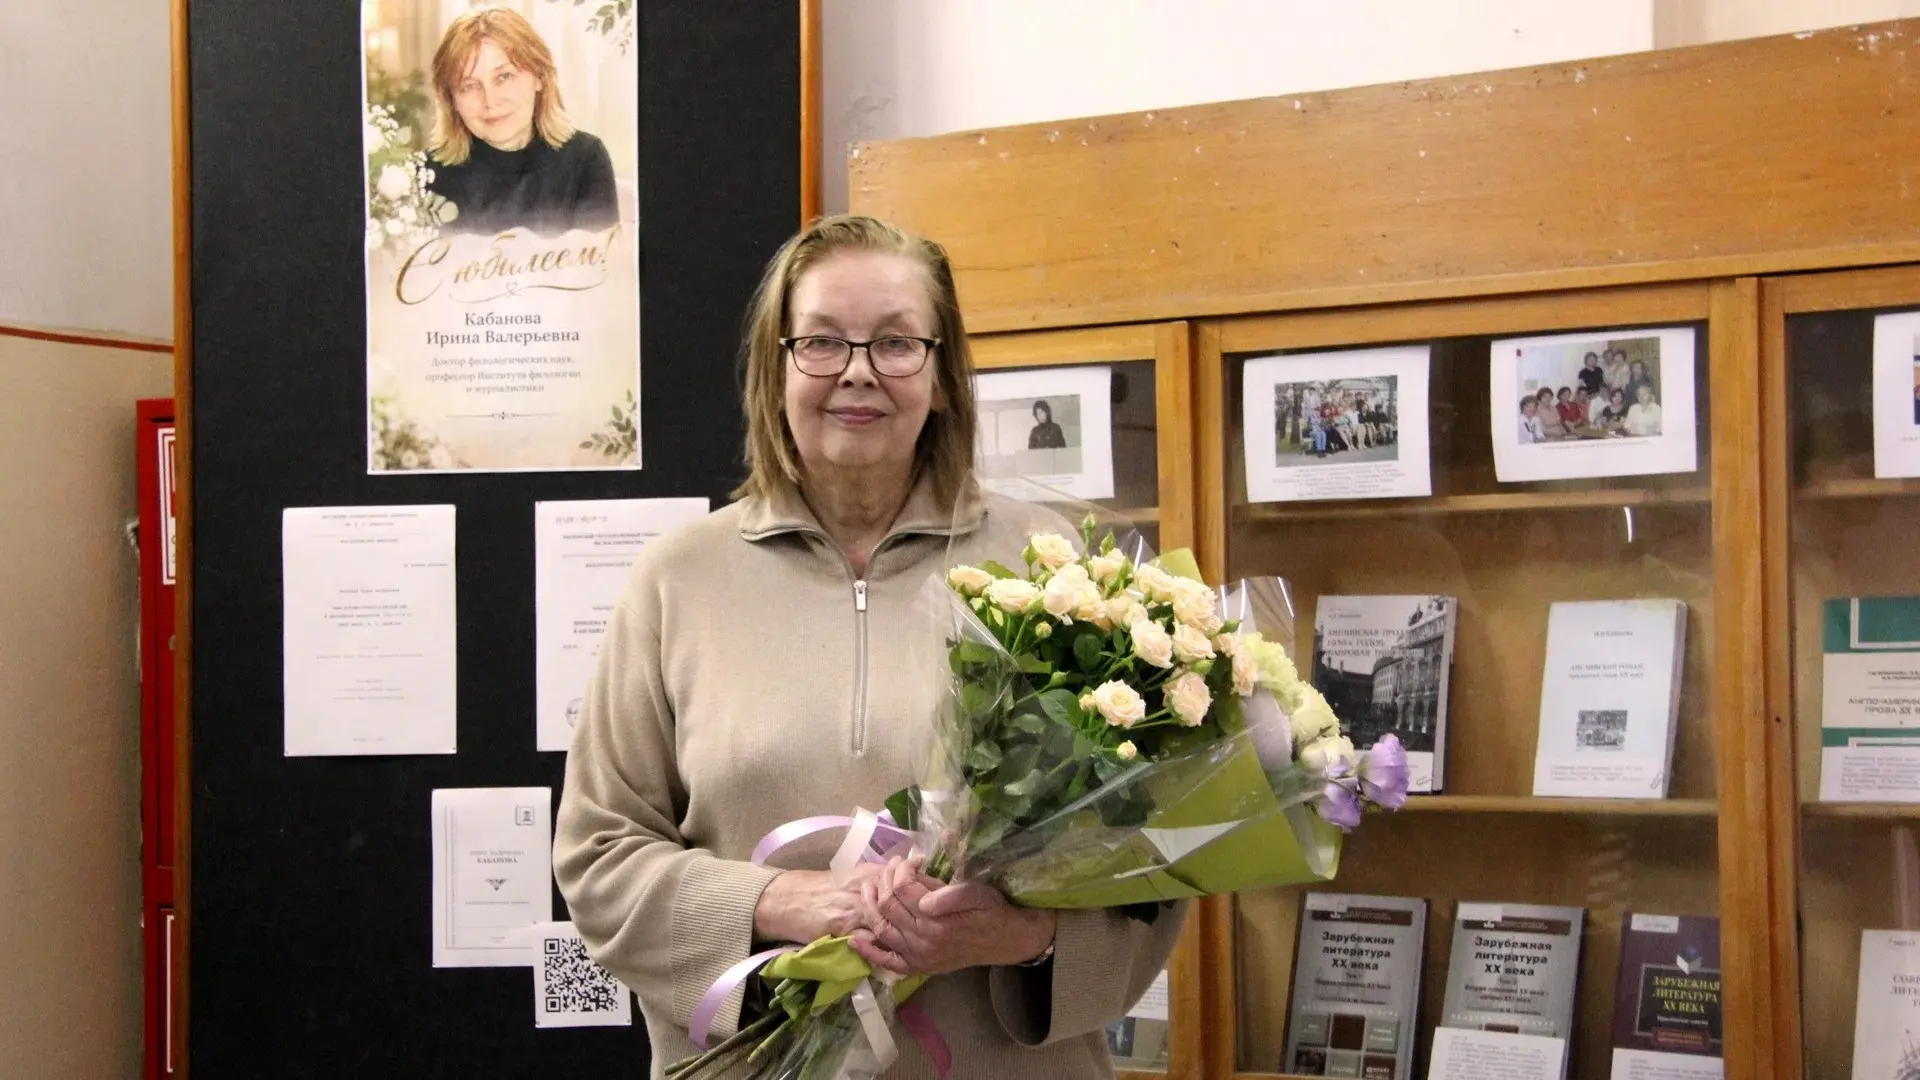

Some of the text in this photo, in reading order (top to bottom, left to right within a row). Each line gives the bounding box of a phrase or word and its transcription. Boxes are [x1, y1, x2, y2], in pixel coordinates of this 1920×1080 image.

[396, 229, 616, 306] С юбилеем!
[465, 311, 542, 326] Кабанова
[426, 329, 580, 348] Ирина Валерьевна
[430, 357, 466, 368] Доктор
[468, 355, 548, 367] филологических
[425, 369, 581, 383] профессор Института филологии
[1322, 931, 1395, 947] Зарубежная
[1475, 936, 1553, 951] Зарубежная
[1322, 945, 1391, 959] литература
[1474, 951, 1548, 965] литература
[1331, 958, 1379, 971] XX века
[1484, 963, 1535, 977] XX века
[1653, 976, 1720, 991] ЗАРУБЕЖНАЯ
[1652, 988, 1718, 1003] ЛИТЕРАТУРА
[1678, 1001, 1705, 1014] ВЕКА
